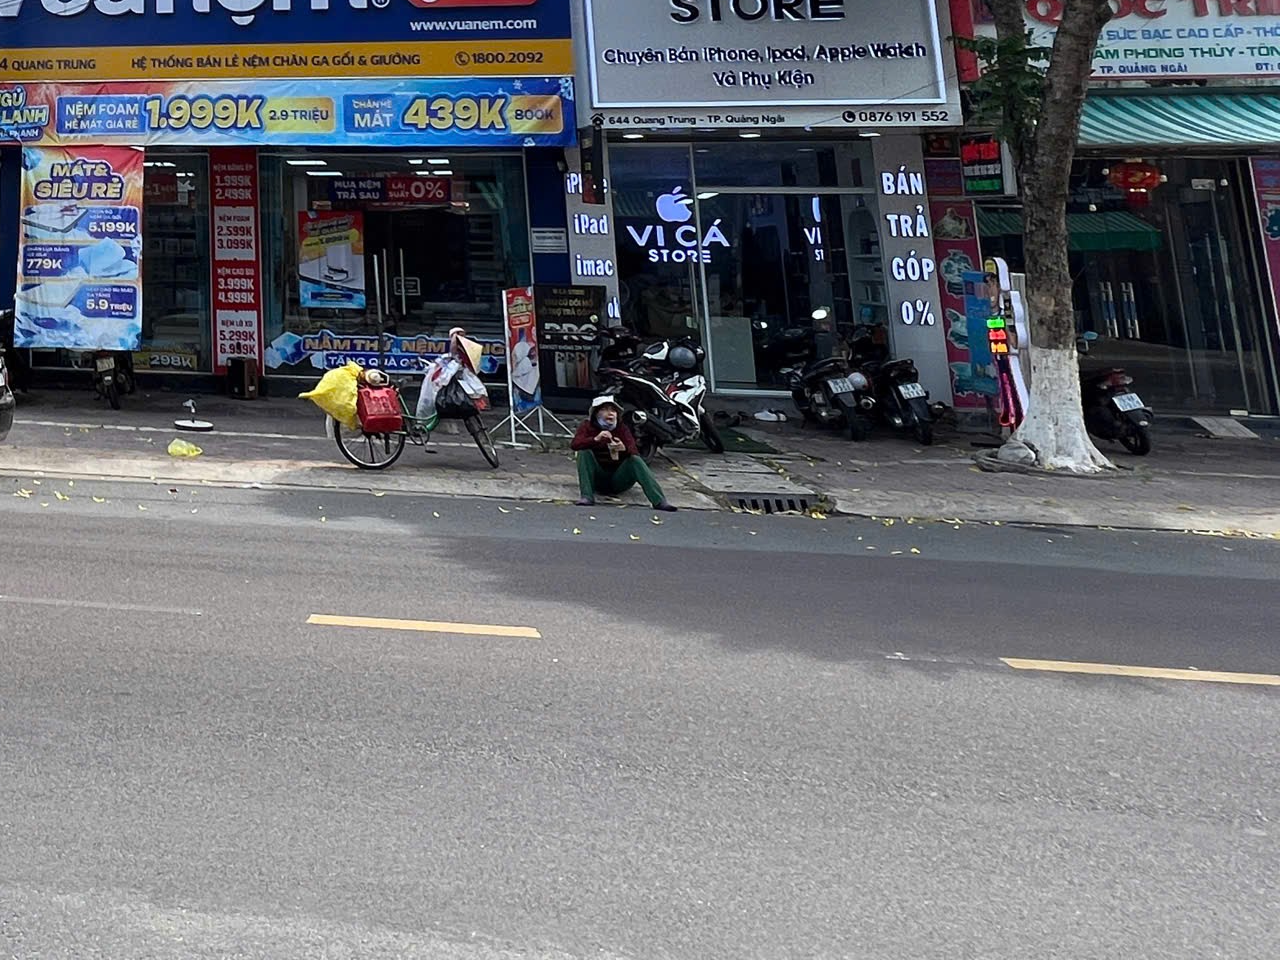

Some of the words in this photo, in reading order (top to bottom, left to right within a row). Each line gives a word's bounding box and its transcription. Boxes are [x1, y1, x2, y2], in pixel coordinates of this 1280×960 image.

[410, 18, 537, 32] www.vuanem.com
[1141, 28, 1173, 41] BẠC
[1177, 27, 1211, 39] CAO
[1213, 24, 1244, 39] CẤP
[472, 52, 543, 65] 1800.2092
[603, 47, 664, 67] Chuyên
[668, 45, 699, 63] Bán
[814, 44, 867, 63] Apple
[870, 42, 926, 60] Watch
[1124, 47, 1184, 59] PHONG
[1189, 43, 1235, 57] THỦY
[11, 59, 53, 71] QUANG
[56, 59, 96, 70] TRUNG
[131, 56, 147, 71] HỆ
[150, 54, 193, 69] THỐNG
[197, 55, 221, 68] BÁN
[225, 54, 239, 68] LẺ
[243, 54, 270, 69] NỆM
[272, 54, 311, 67] CHĂN
[312, 55, 329, 66] GA
[332, 52, 354, 66] GỐI
[358, 55, 367, 66] &
[370, 52, 420, 66] GIƯỜNG
[1118, 62, 1157, 74] QUẢNG
[1161, 63, 1188, 73] NGÃI
[712, 70, 736, 88] Và
[740, 71, 772, 90] Phụ
[2, 107, 46, 126] LẠNH
[65, 102, 97, 117] NỆM
[99, 103, 139, 116] FOAM
[147, 97, 263, 130] 1.999K
[268, 110, 289, 121] 2.9
[291, 109, 329, 124] TRIỆU
[404, 97, 508, 130] 439K
[514, 109, 554, 121] 800K
[859, 111, 893, 122] 0876
[896, 111, 916, 122] 191
[921, 111, 948, 122] 552
[106, 117, 123, 129] GIÁ
[124, 117, 138, 129] RẺ
[354, 109, 393, 128] MÁT
[609, 116, 629, 125] 644
[633, 116, 665, 126] Quang
[667, 115, 696, 126] Trung
[707, 115, 723, 123] TP.
[725, 113, 759, 125] Quảng
[761, 114, 785, 125] Ngãi
[334, 180, 357, 189] MUA
[359, 179, 381, 190] NỆM
[881, 165, 924, 195] BÁN
[36, 179, 88, 199] SIÊU
[91, 178, 122, 199] RẺ
[336, 190, 357, 200] TRẢ
[360, 191, 380, 200] SAU
[410, 181, 444, 199] 0%
[574, 214, 609, 234] iPad
[886, 205, 929, 237] TRẢ
[217, 225, 253, 237] 2.599K
[626, 225, 665, 247] VI
[675, 218, 730, 247] CÁ
[217, 238, 253, 250] 3.099K
[26, 258, 62, 270] 779K
[648, 249, 712, 264] STORE
[576, 254, 614, 276] imac
[892, 250, 935, 281] GÓP
[217, 278, 254, 290] 3.999K
[217, 291, 255, 304] 4.999K
[902, 300, 935, 326] 0%
[219, 330, 256, 342] 5.299K
[402, 337, 446, 354] NỆM
[150, 354, 192, 368] 298K
